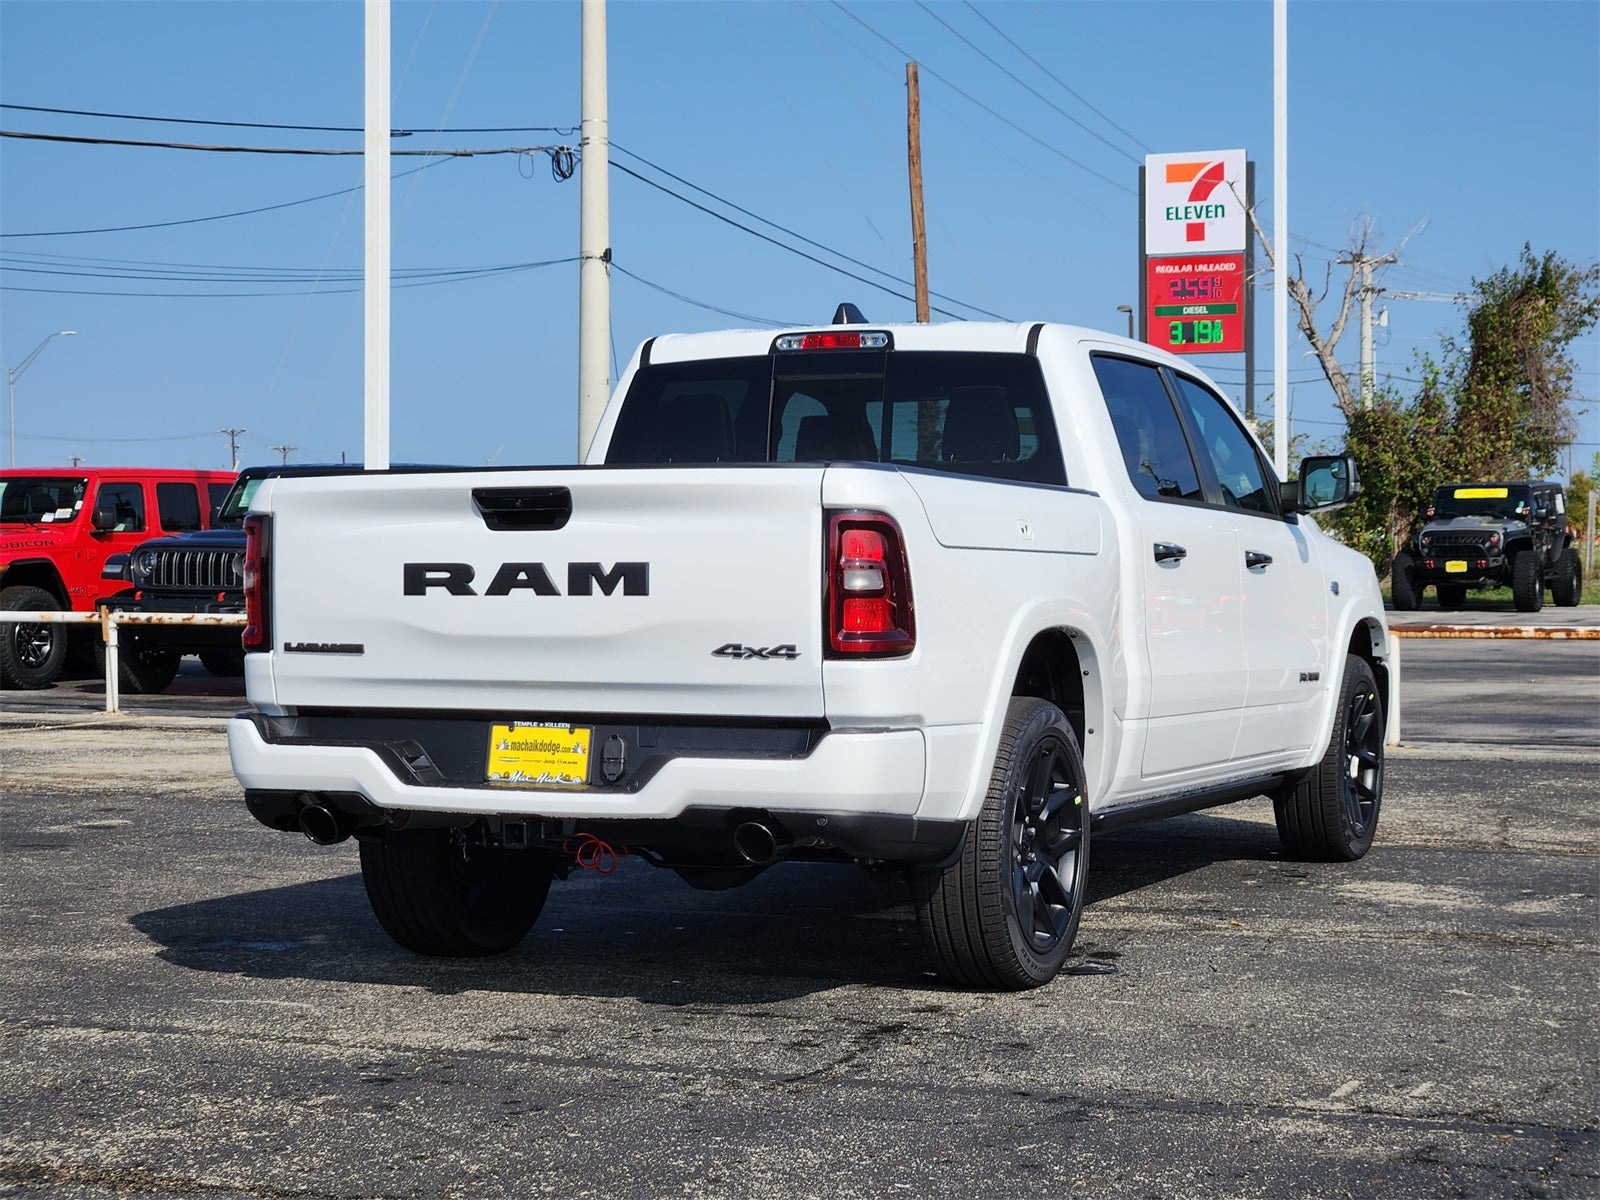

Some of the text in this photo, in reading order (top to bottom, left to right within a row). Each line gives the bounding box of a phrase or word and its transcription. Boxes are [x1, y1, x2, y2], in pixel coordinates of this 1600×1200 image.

[1155, 262, 1236, 273] REGULAR UNLEADED
[1182, 306, 1209, 315] DIESEL
[403, 562, 650, 597] RAM
[711, 643, 802, 660] 4x4
[510, 739, 571, 755] machaikdodge.com
[508, 770, 532, 782] Mac
